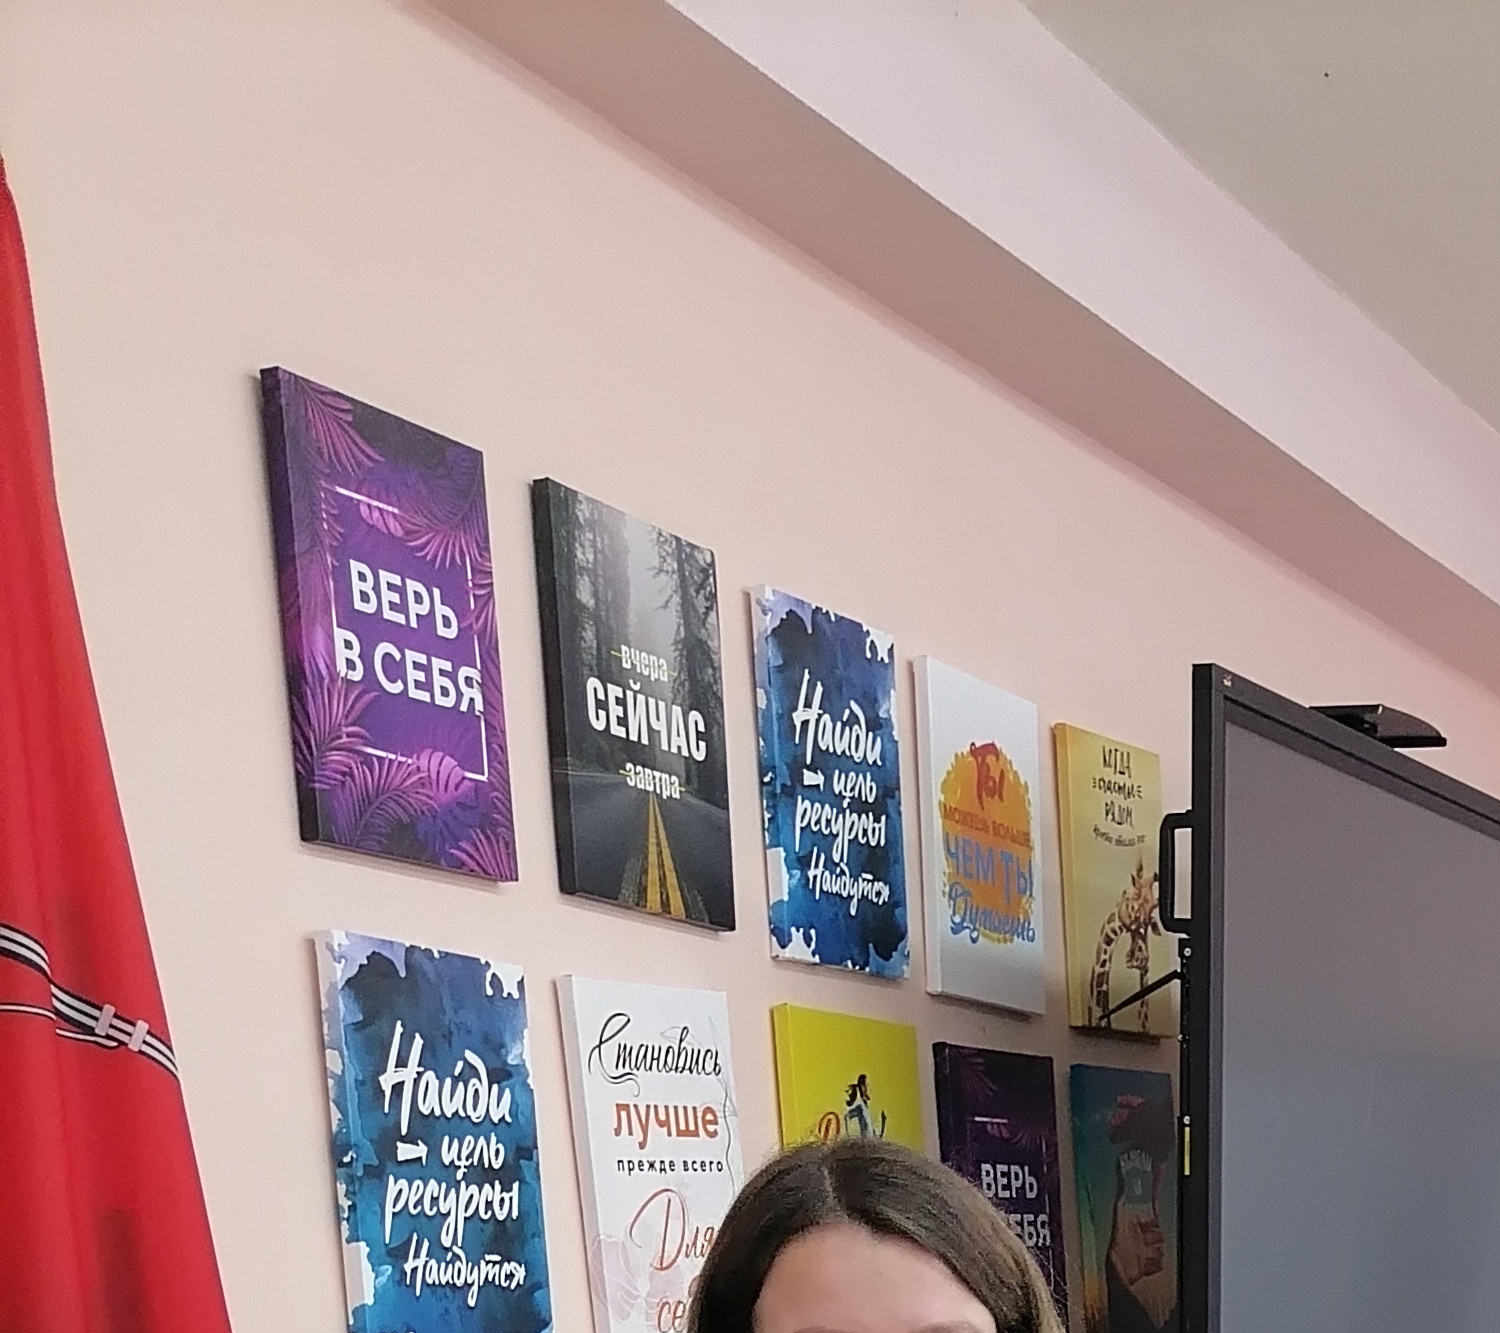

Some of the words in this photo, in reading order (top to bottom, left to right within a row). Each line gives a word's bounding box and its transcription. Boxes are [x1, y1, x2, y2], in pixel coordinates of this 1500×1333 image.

[349, 559, 459, 639] ВЕРЬ
[334, 626, 364, 681] В
[374, 641, 485, 716] СЕБЯ
[621, 644, 670, 683] вчера
[585, 675, 707, 762] СЕЙЧАС
[792, 669, 882, 767] Найди
[625, 762, 682, 800] завтра
[832, 768, 877, 809] цель
[795, 795, 887, 863] ресурсы
[807, 852, 890, 916] Найдутся
[944, 832, 996, 887] ЧЕМ
[1000, 850, 1034, 906] ТЫ
[378, 1020, 512, 1136] Найди
[588, 1012, 722, 1098] Становись
[441, 1132, 506, 1178] цель
[613, 1102, 719, 1151] лучше
[616, 1157, 677, 1177] прежде
[683, 1157, 724, 1173] всего
[980, 1163, 1039, 1200] ВЕРЬ
[385, 1173, 520, 1249] ресурсы
[629, 1187, 716, 1272] Для
[1009, 1213, 1051, 1247] ЕБЯ
[403, 1232, 526, 1307] Найдутся
